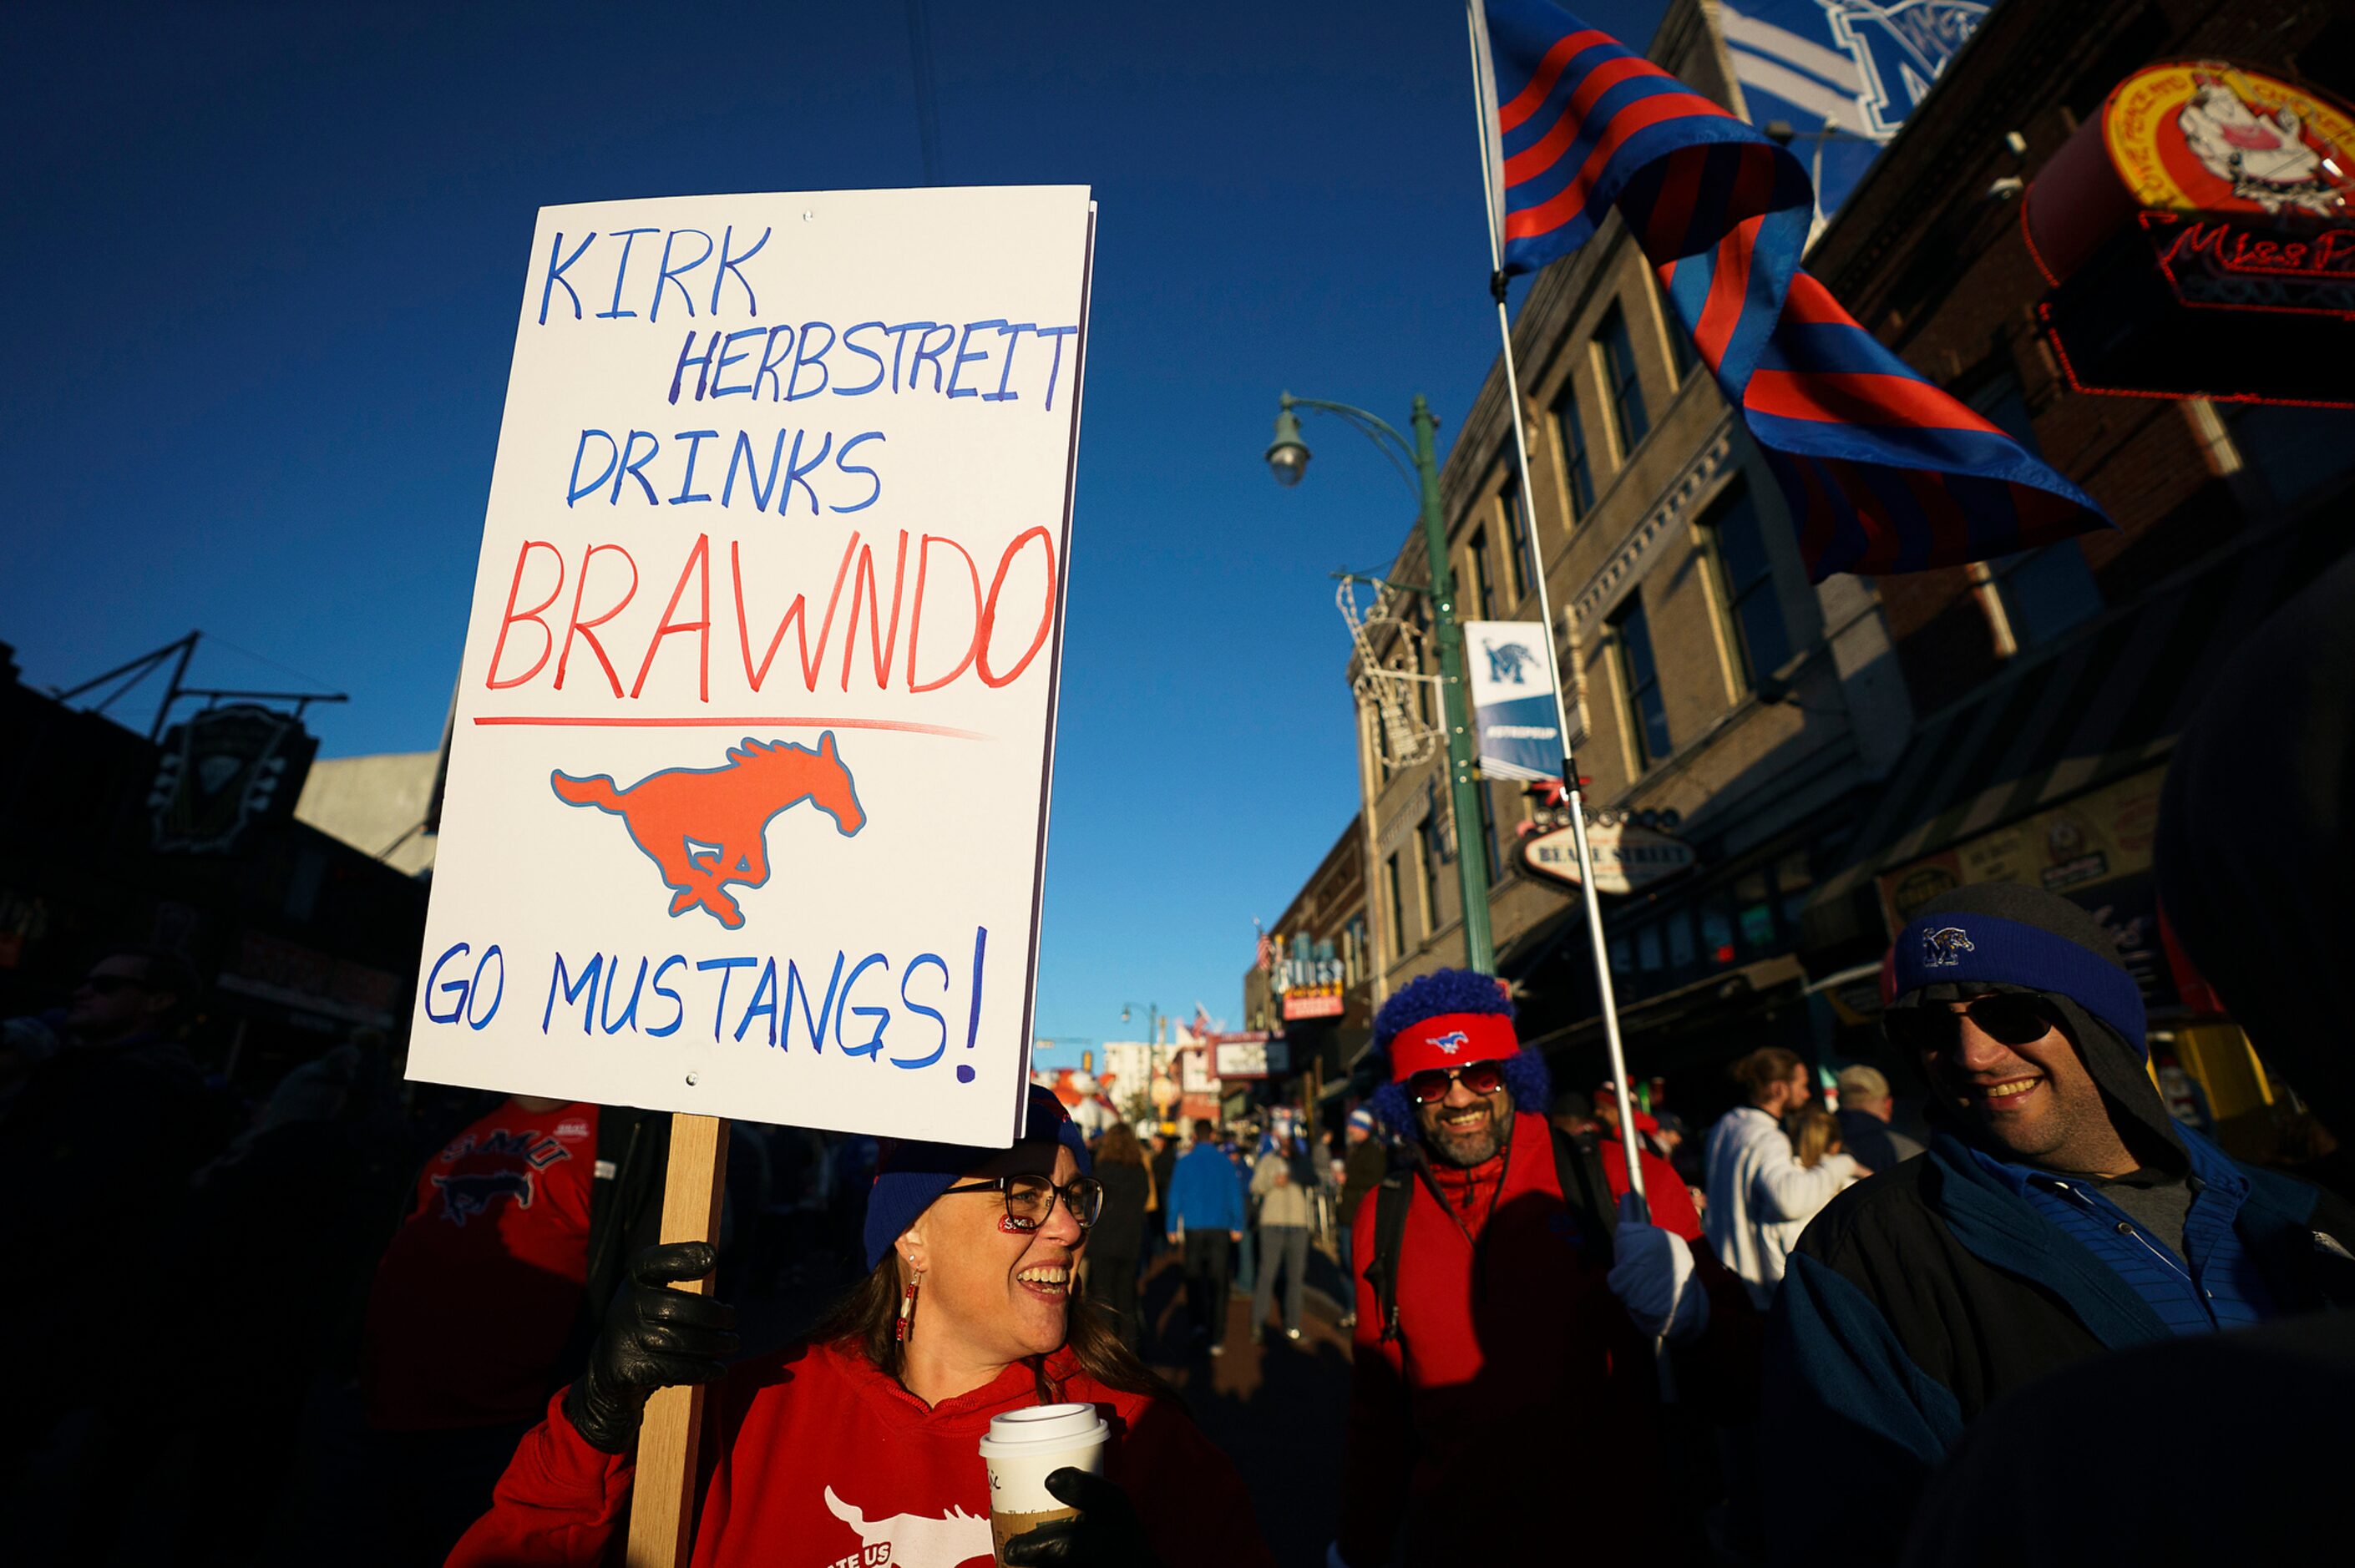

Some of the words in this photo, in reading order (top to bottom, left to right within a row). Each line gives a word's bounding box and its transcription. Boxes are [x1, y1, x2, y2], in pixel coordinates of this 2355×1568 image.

[538, 225, 772, 325] KIRK
[2161, 220, 2309, 271] Miss
[669, 318, 1078, 412] HERBSTREIT
[567, 427, 886, 517] DRINKS
[485, 526, 1056, 703] BRAWNDO
[1537, 846, 1601, 863] BEAE
[1611, 847, 1687, 864] STREET
[425, 943, 504, 1031] GO
[541, 925, 988, 1084] MUSTANGS!
[441, 1129, 572, 1171] SMU
[864, 1544, 890, 1566] US
